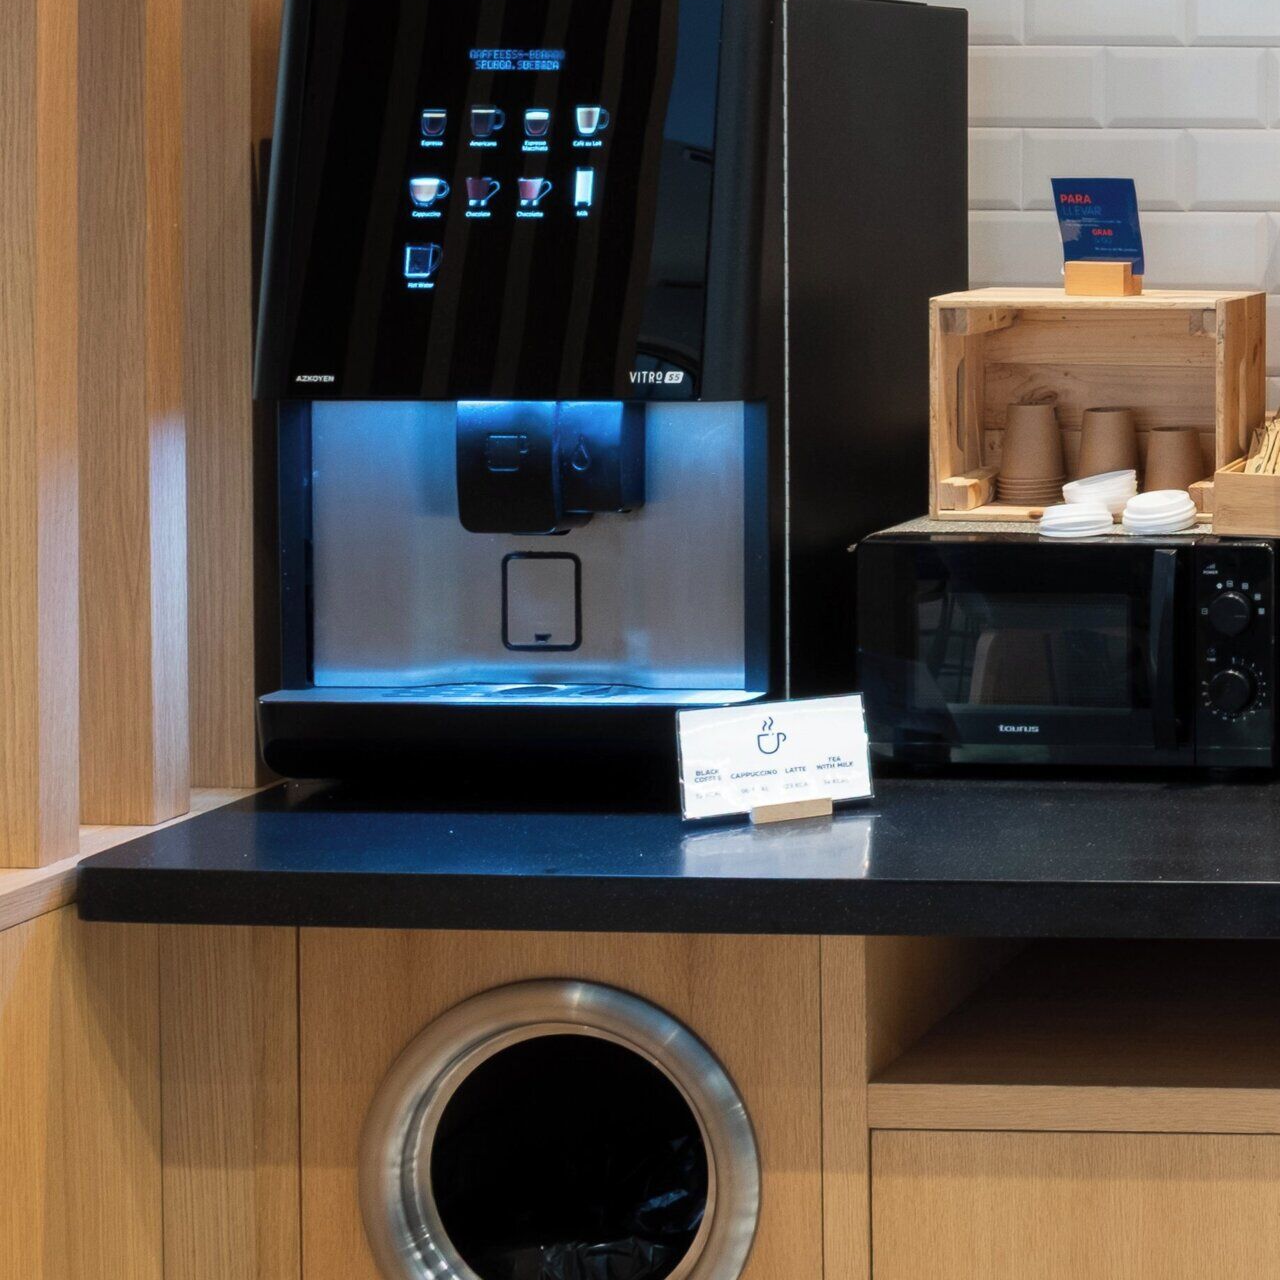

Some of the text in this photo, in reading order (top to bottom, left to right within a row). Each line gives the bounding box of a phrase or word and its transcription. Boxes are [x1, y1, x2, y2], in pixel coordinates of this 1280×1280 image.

[1060, 194, 1091, 204] PARA
[296, 375, 334, 383] AZKOYEN
[998, 724, 1040, 733] taurus
[730, 769, 777, 779] CAPPUCCINO
